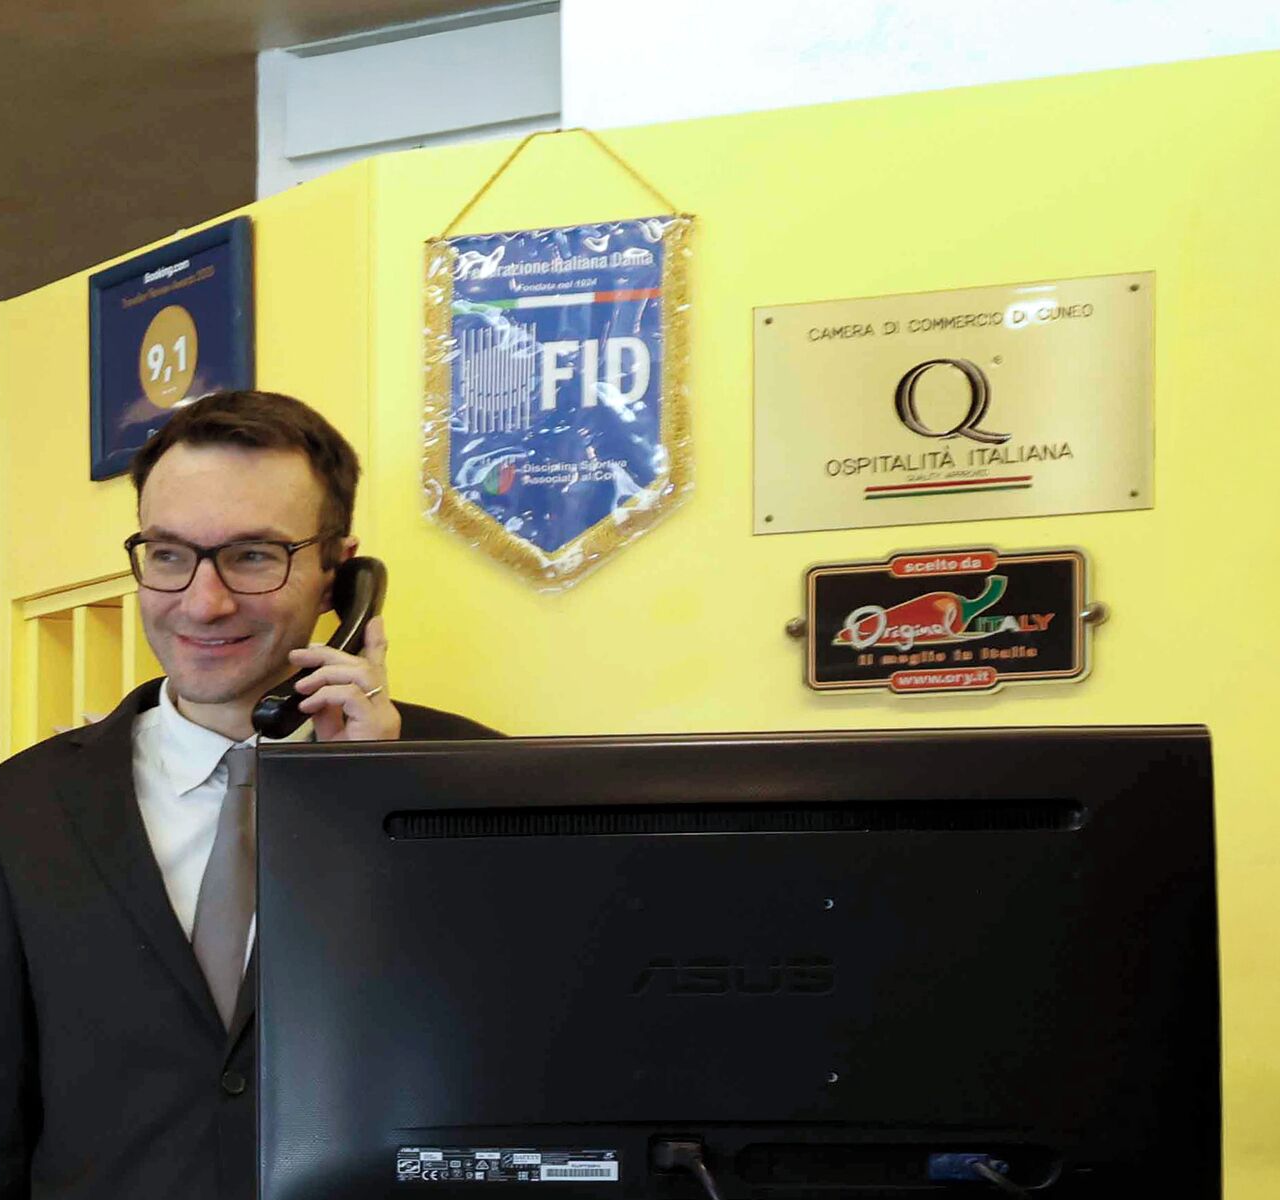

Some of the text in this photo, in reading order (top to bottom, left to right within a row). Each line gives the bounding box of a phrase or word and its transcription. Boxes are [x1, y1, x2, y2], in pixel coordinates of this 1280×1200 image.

[463, 258, 550, 280] Ferazione
[611, 250, 654, 268] Dama
[808, 323, 875, 341] CAMERA
[883, 320, 900, 335] DI
[908, 311, 1004, 333] COMMERCIO
[1037, 303, 1094, 321] CUNEO
[146, 335, 187, 383] 9,1
[541, 336, 651, 411] FID
[894, 358, 1012, 444] Q
[825, 441, 1074, 477] OSPITALITÀ ITALIANA
[903, 556, 982, 573] scelto da
[976, 612, 1056, 632] ITALY
[881, 650, 946, 666] meglio
[627, 956, 838, 997] ASUS
